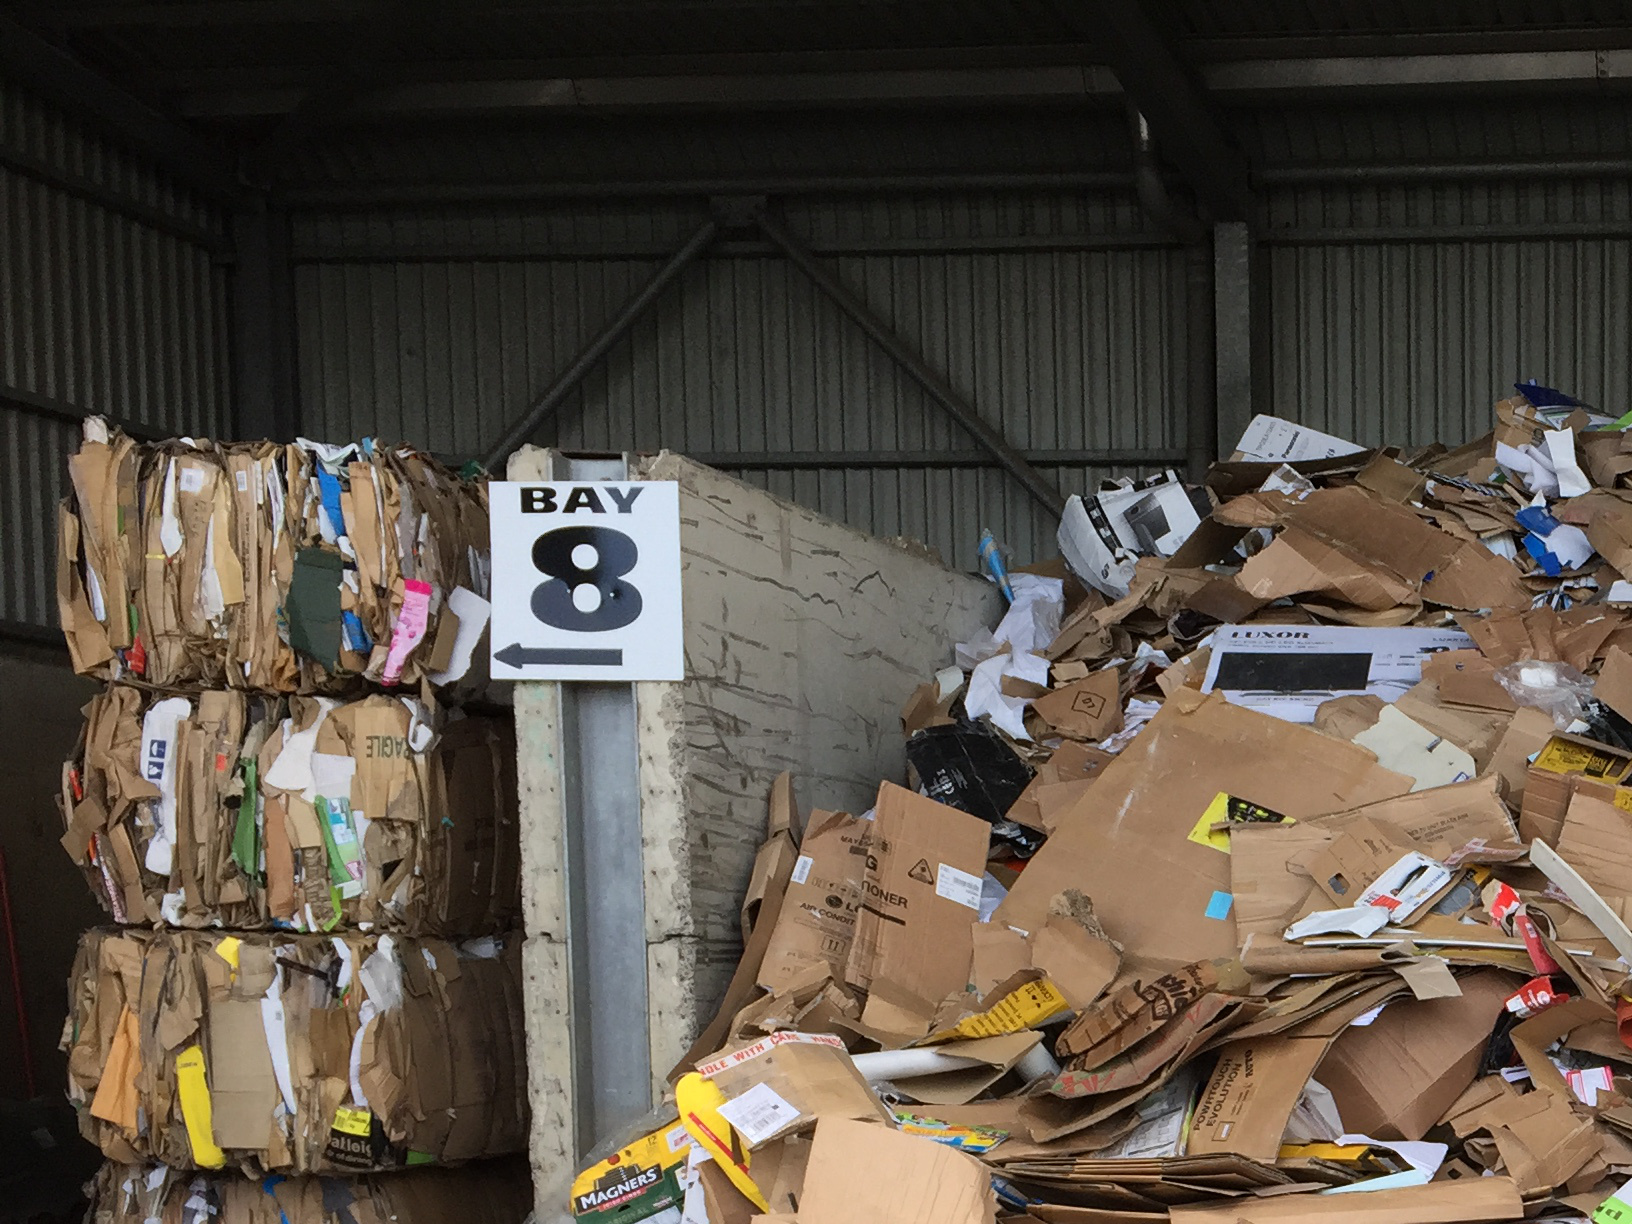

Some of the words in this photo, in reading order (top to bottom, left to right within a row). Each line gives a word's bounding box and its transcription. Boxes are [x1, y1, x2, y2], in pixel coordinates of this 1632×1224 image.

[520, 487, 644, 514] BAY
[530, 525, 643, 632] 8
[1231, 631, 1310, 639] LUXOR
[733, 1043, 765, 1062] WITH
[1193, 1058, 1233, 1131] POWRTOUCH
[1206, 1063, 1242, 1127] EVOLUTION
[580, 1168, 658, 1210] MAGNERS
